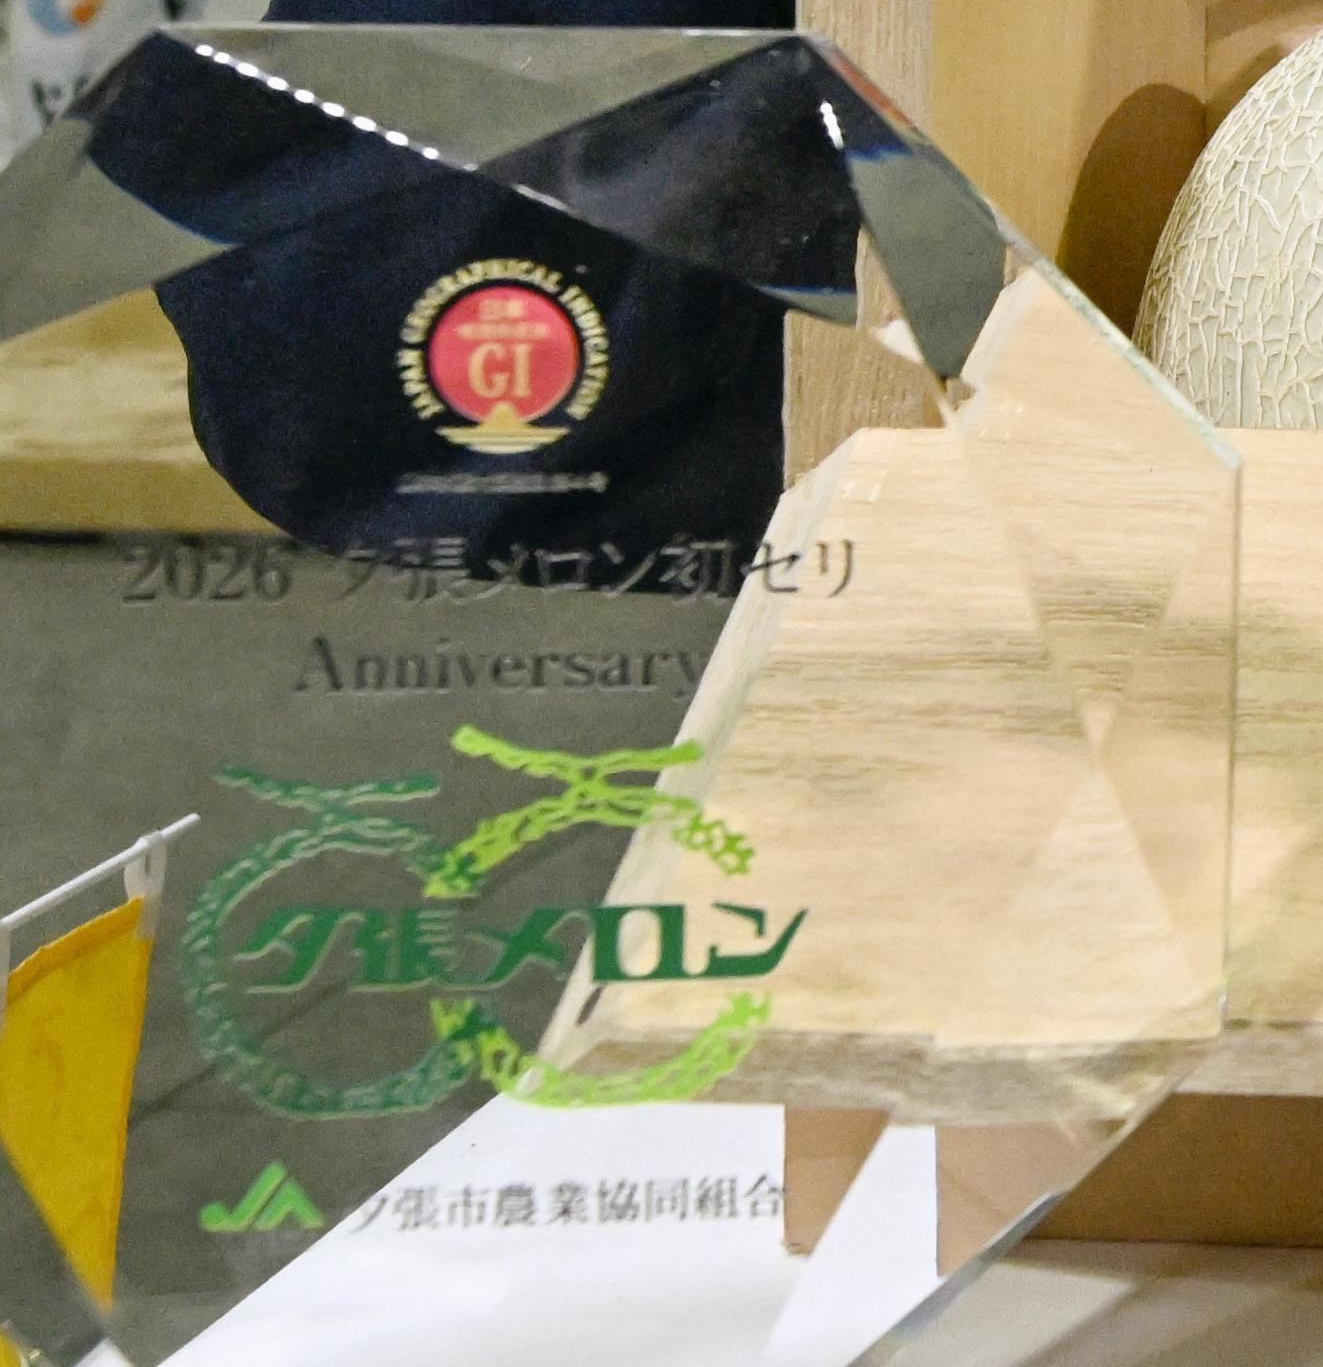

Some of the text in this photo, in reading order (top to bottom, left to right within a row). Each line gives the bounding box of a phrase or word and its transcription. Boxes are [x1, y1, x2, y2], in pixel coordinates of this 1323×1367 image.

[468, 342, 532, 399] GI
[121, 540, 294, 604] 2026
[292, 634, 708, 700] Anniversary
[233, 902, 810, 994] 夕張メロン
